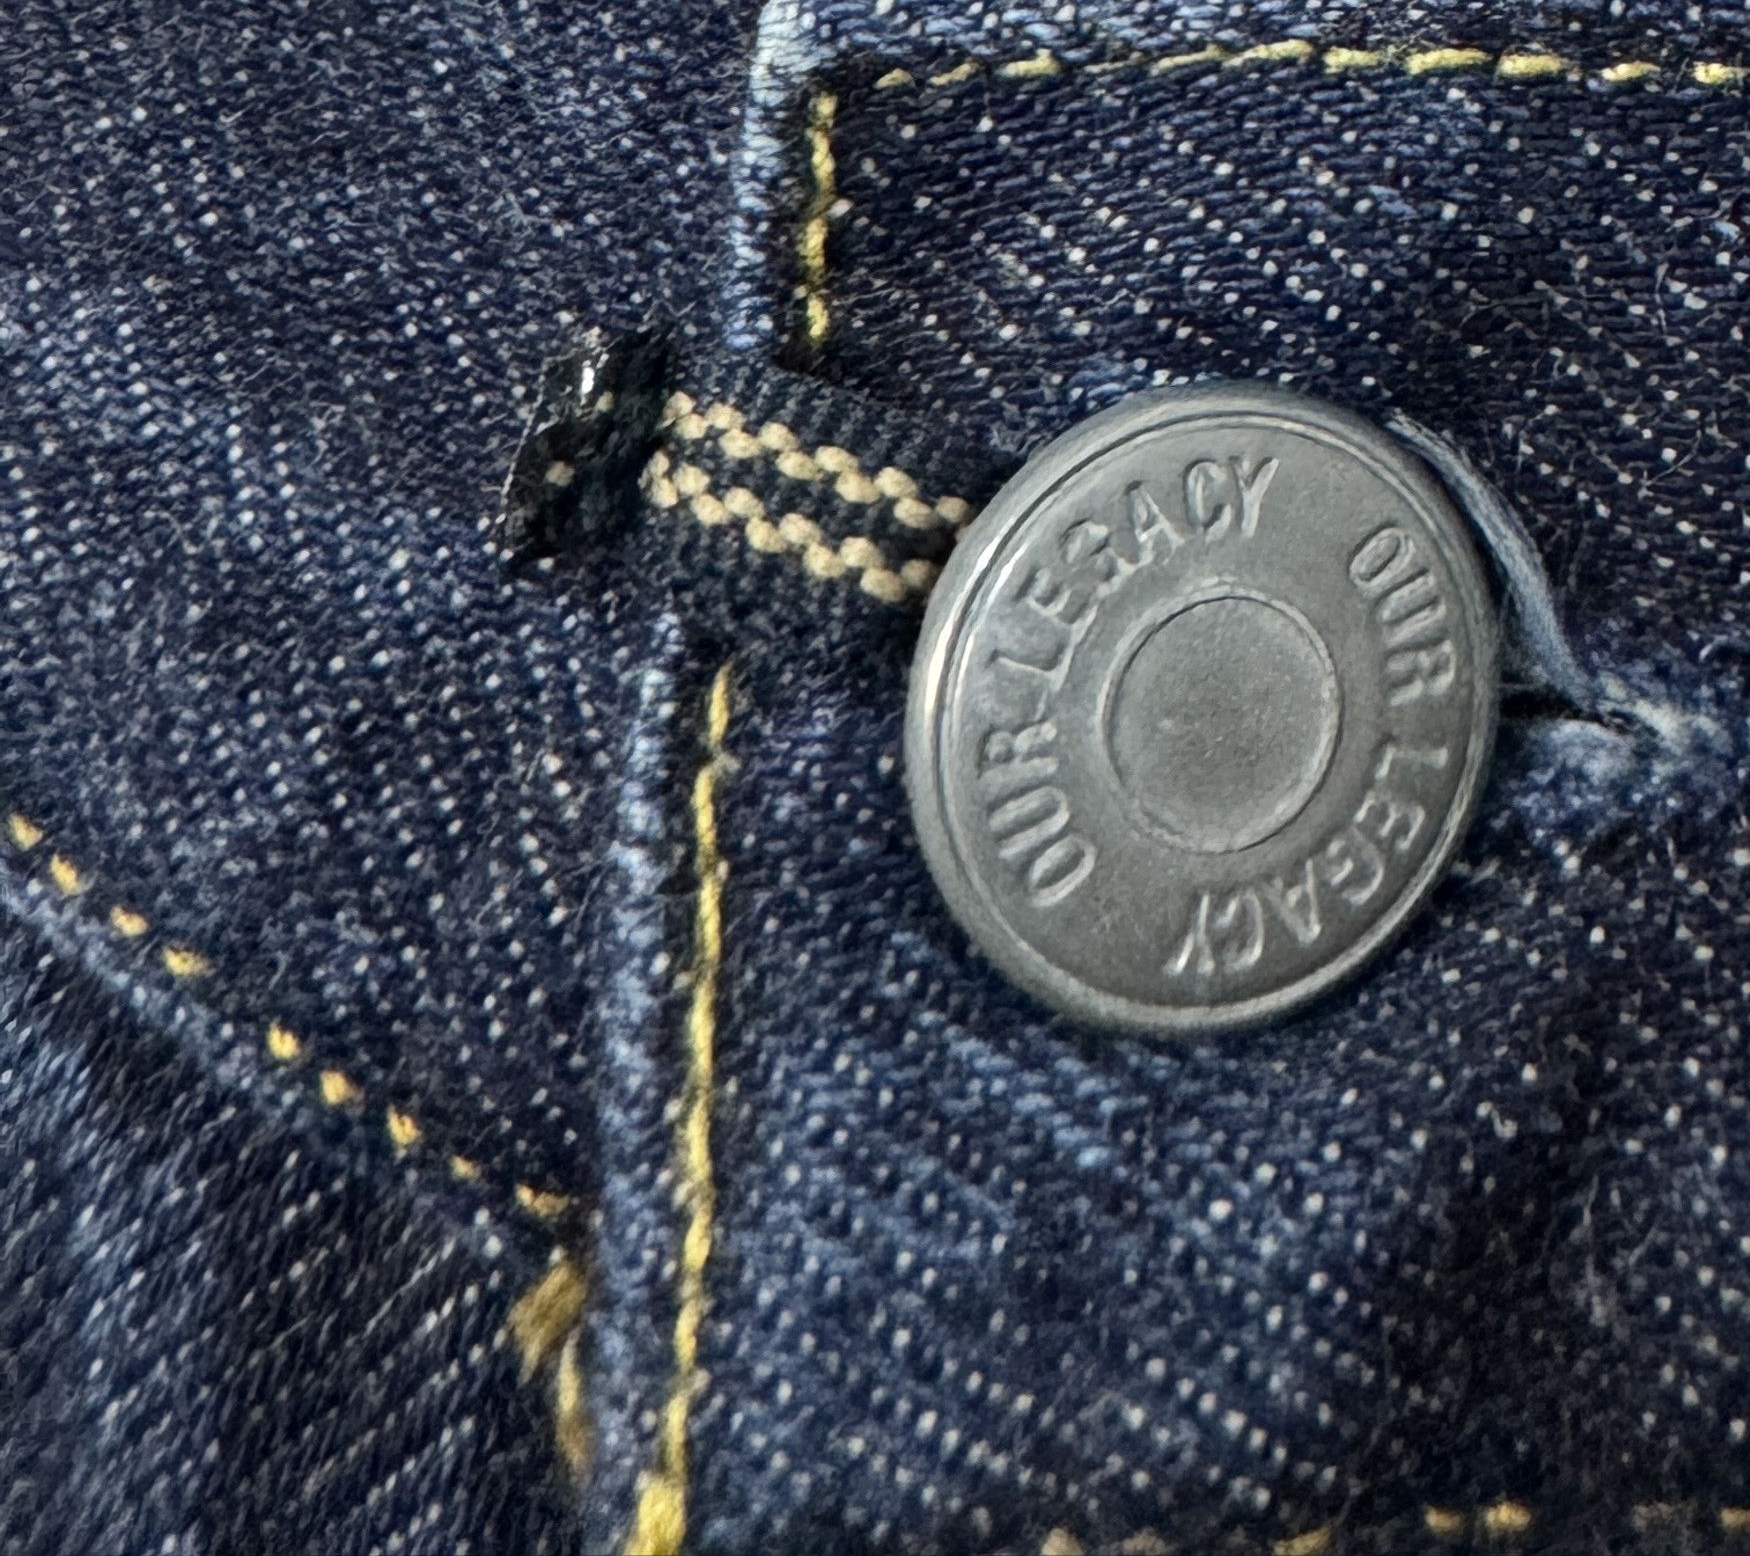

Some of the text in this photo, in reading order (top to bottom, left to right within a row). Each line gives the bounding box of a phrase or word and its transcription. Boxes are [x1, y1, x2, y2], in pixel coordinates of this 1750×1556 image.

[977, 456, 1281, 908] OUR LEGACY
[1162, 523, 1458, 977] OUR LEGACY
